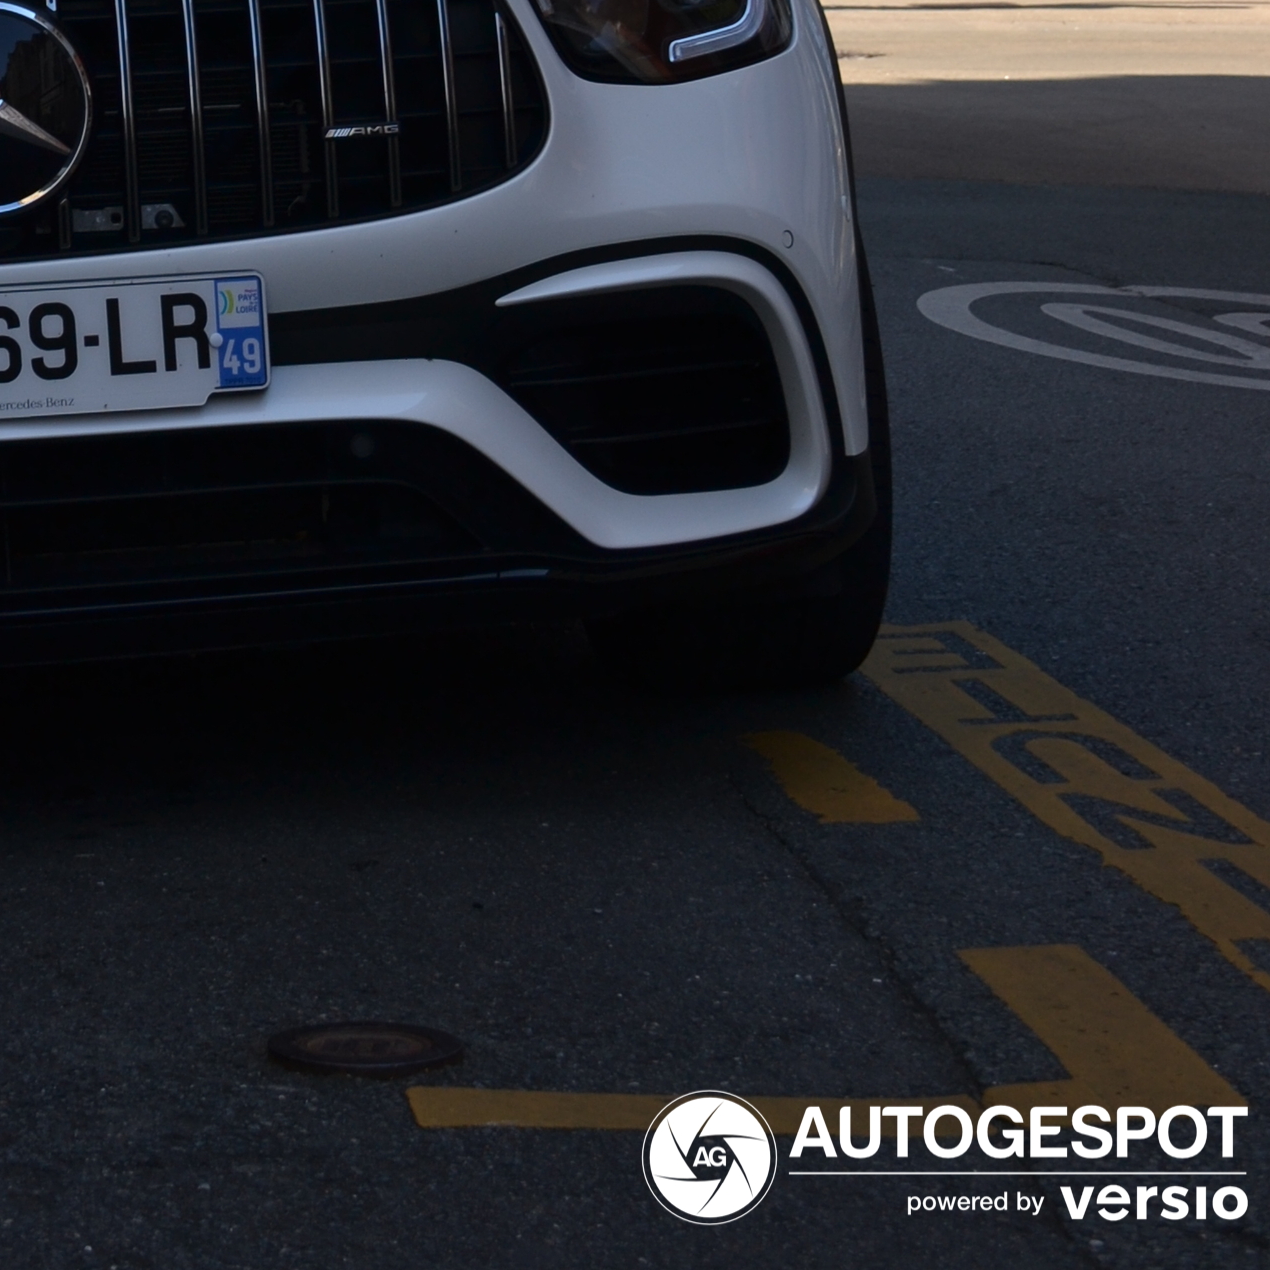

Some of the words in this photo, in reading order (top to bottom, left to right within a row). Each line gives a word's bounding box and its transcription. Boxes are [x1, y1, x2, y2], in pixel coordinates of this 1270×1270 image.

[349, 124, 399, 136] AMG
[237, 293, 258, 302] PAYS
[235, 305, 258, 314] LOIRE
[223, 337, 261, 375] 49
